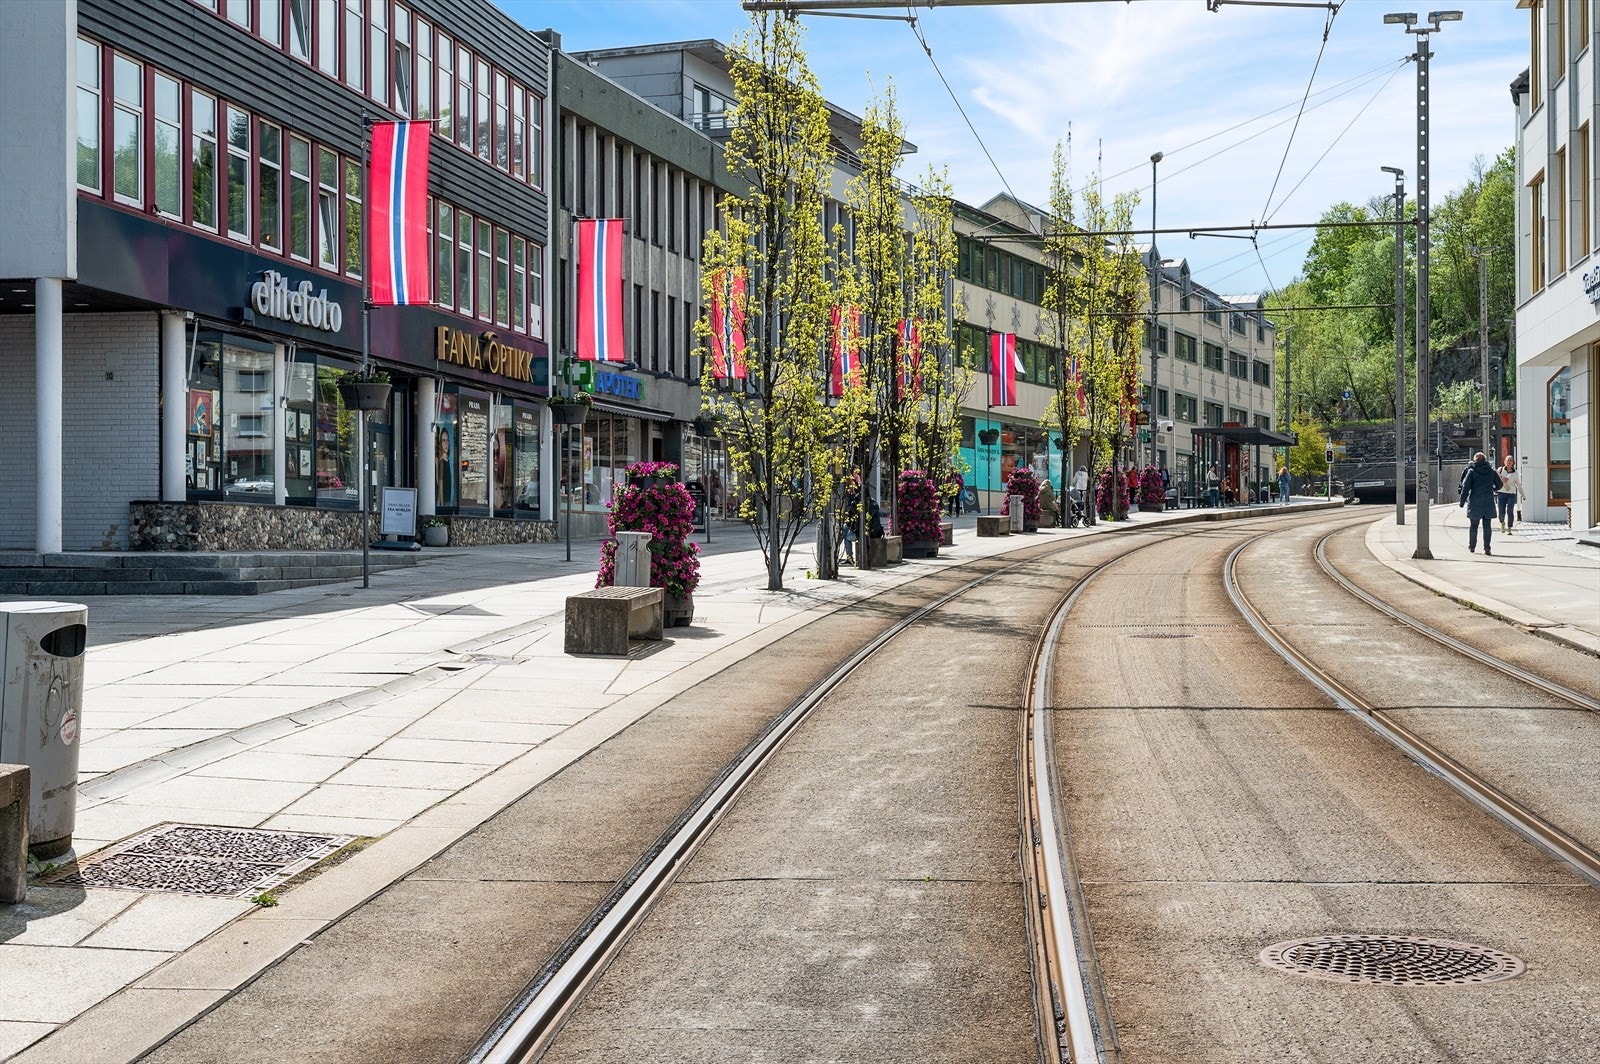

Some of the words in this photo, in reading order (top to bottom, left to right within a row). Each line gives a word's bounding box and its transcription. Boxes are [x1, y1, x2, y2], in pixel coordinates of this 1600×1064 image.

[252, 270, 342, 333] elitefoto
[437, 325, 483, 370] FANA
[485, 340, 534, 383] OPTIKK
[596, 370, 640, 399] APOTEK
